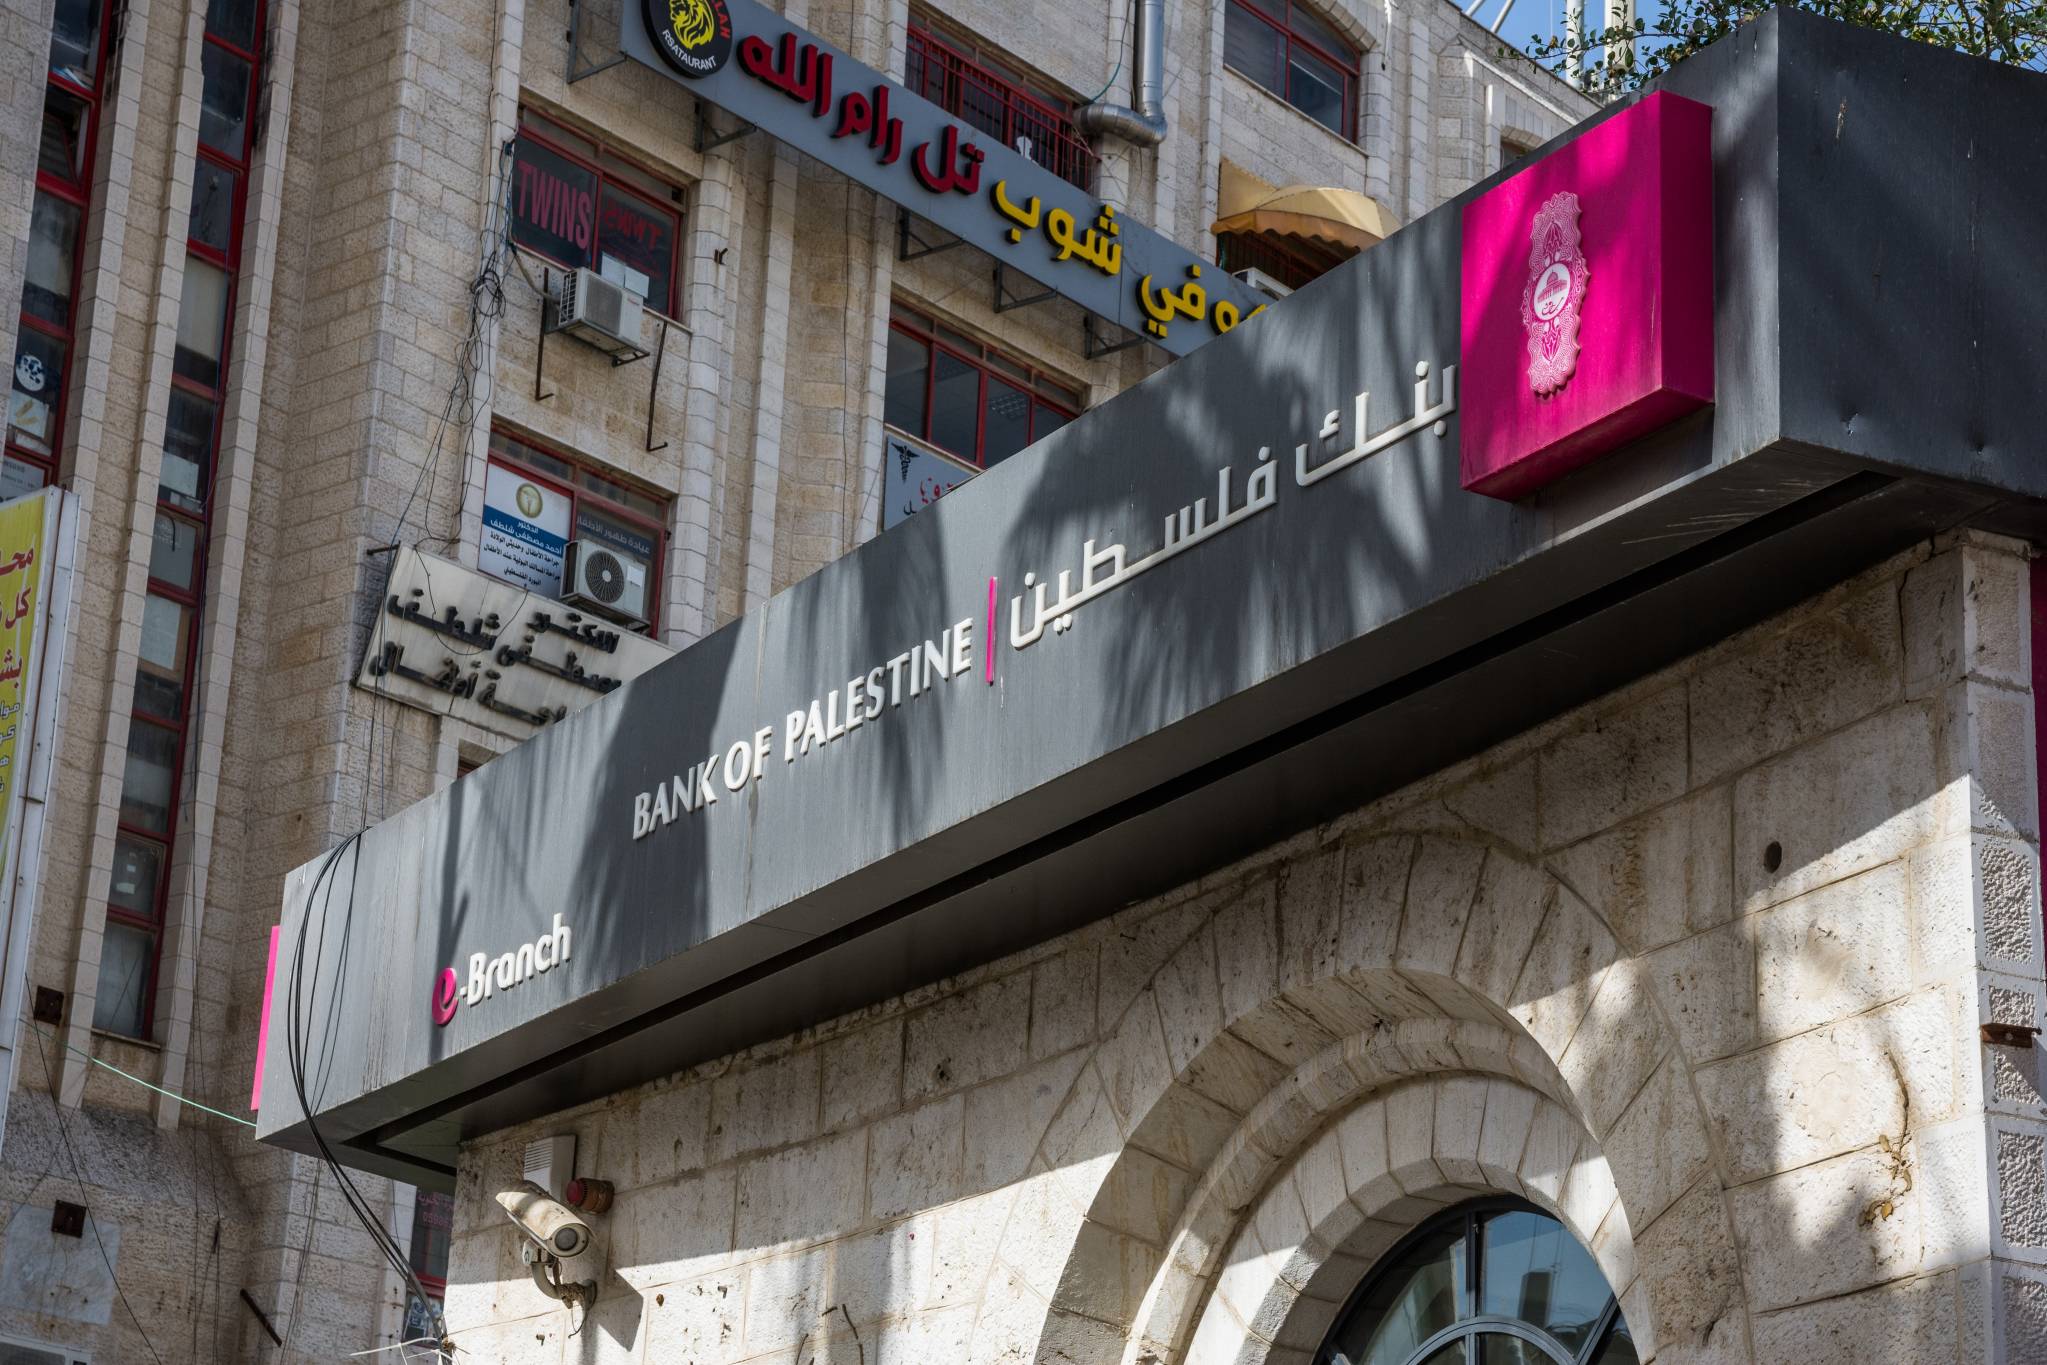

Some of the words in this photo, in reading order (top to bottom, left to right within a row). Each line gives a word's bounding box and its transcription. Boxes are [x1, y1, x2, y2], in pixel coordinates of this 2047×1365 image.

[737, 32, 834, 118] الله
[829, 84, 904, 166] رام
[910, 124, 985, 195] تل
[517, 160, 592, 249] TWINS
[989, 180, 1123, 276] شوب
[1296, 360, 1457, 487] بنك
[516, 531, 544, 548] مصطفى
[1010, 446, 1278, 650] فلسطين
[633, 754, 719, 840] BANK
[724, 726, 773, 792] OF
[784, 617, 974, 764] PALESTINE
[432, 912, 571, 1026] e-Branch
